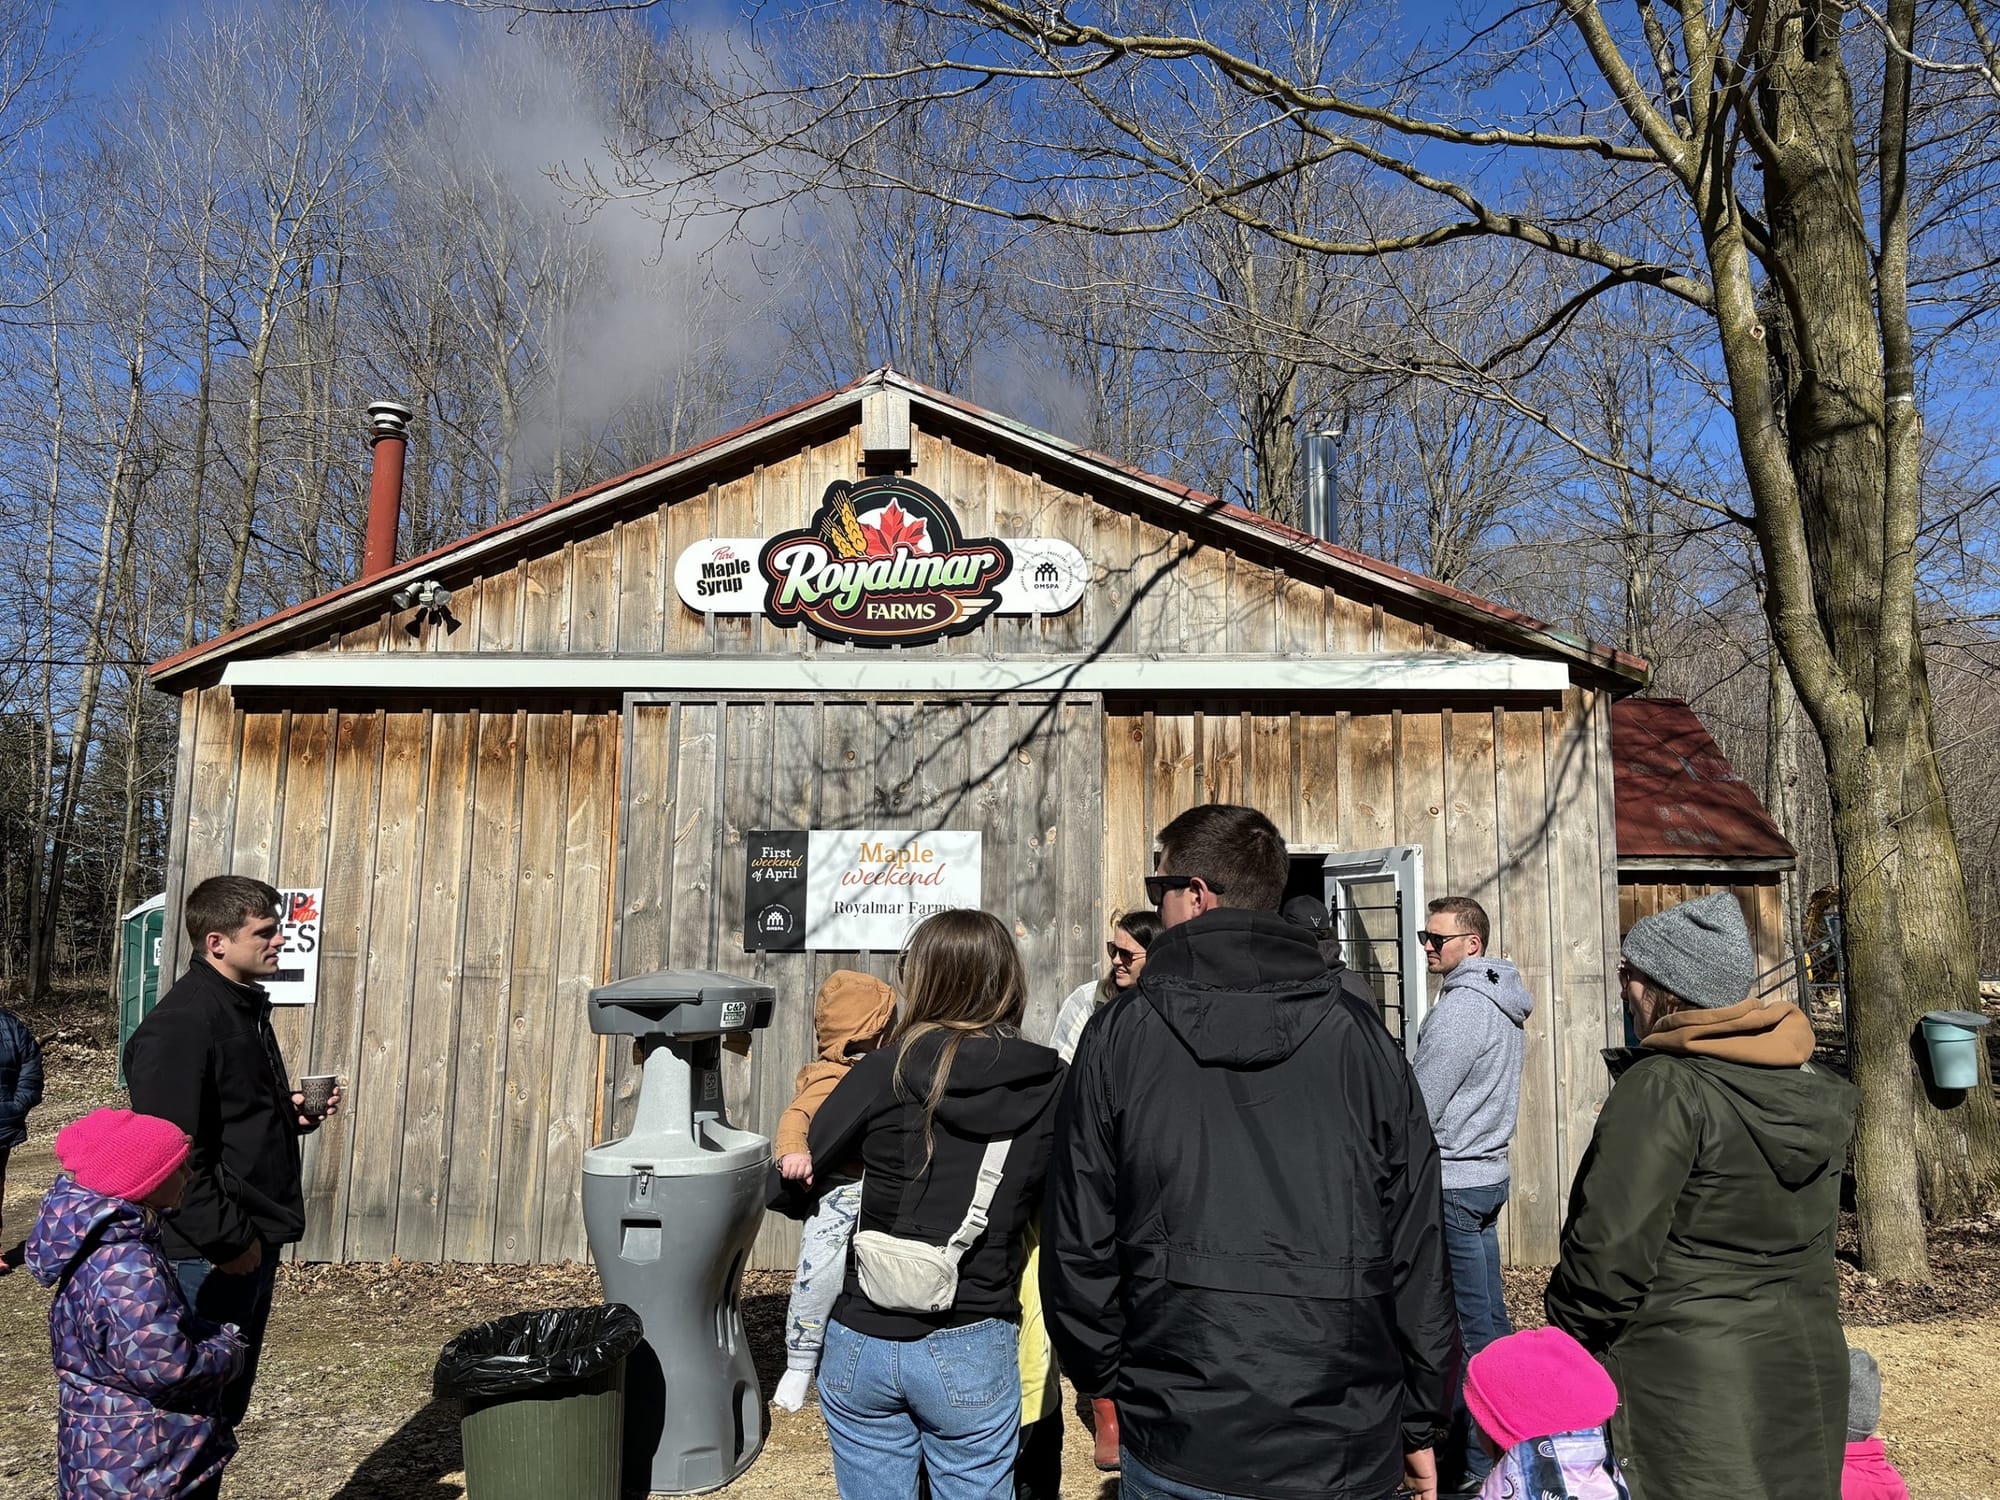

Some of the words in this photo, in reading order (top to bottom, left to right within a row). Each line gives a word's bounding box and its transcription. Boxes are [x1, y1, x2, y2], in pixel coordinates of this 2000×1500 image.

[701, 559, 751, 579] Maple
[773, 544, 995, 611] Royalmar
[696, 577, 743, 596] Syrup
[866, 603, 936, 621] FARMS
[761, 846, 792, 858] First
[859, 841, 934, 869] Maple
[751, 855, 804, 868] weekend
[751, 868, 764, 883] of
[764, 867, 798, 882] April
[841, 863, 946, 887] weekend
[834, 901, 904, 917] Royalmar
